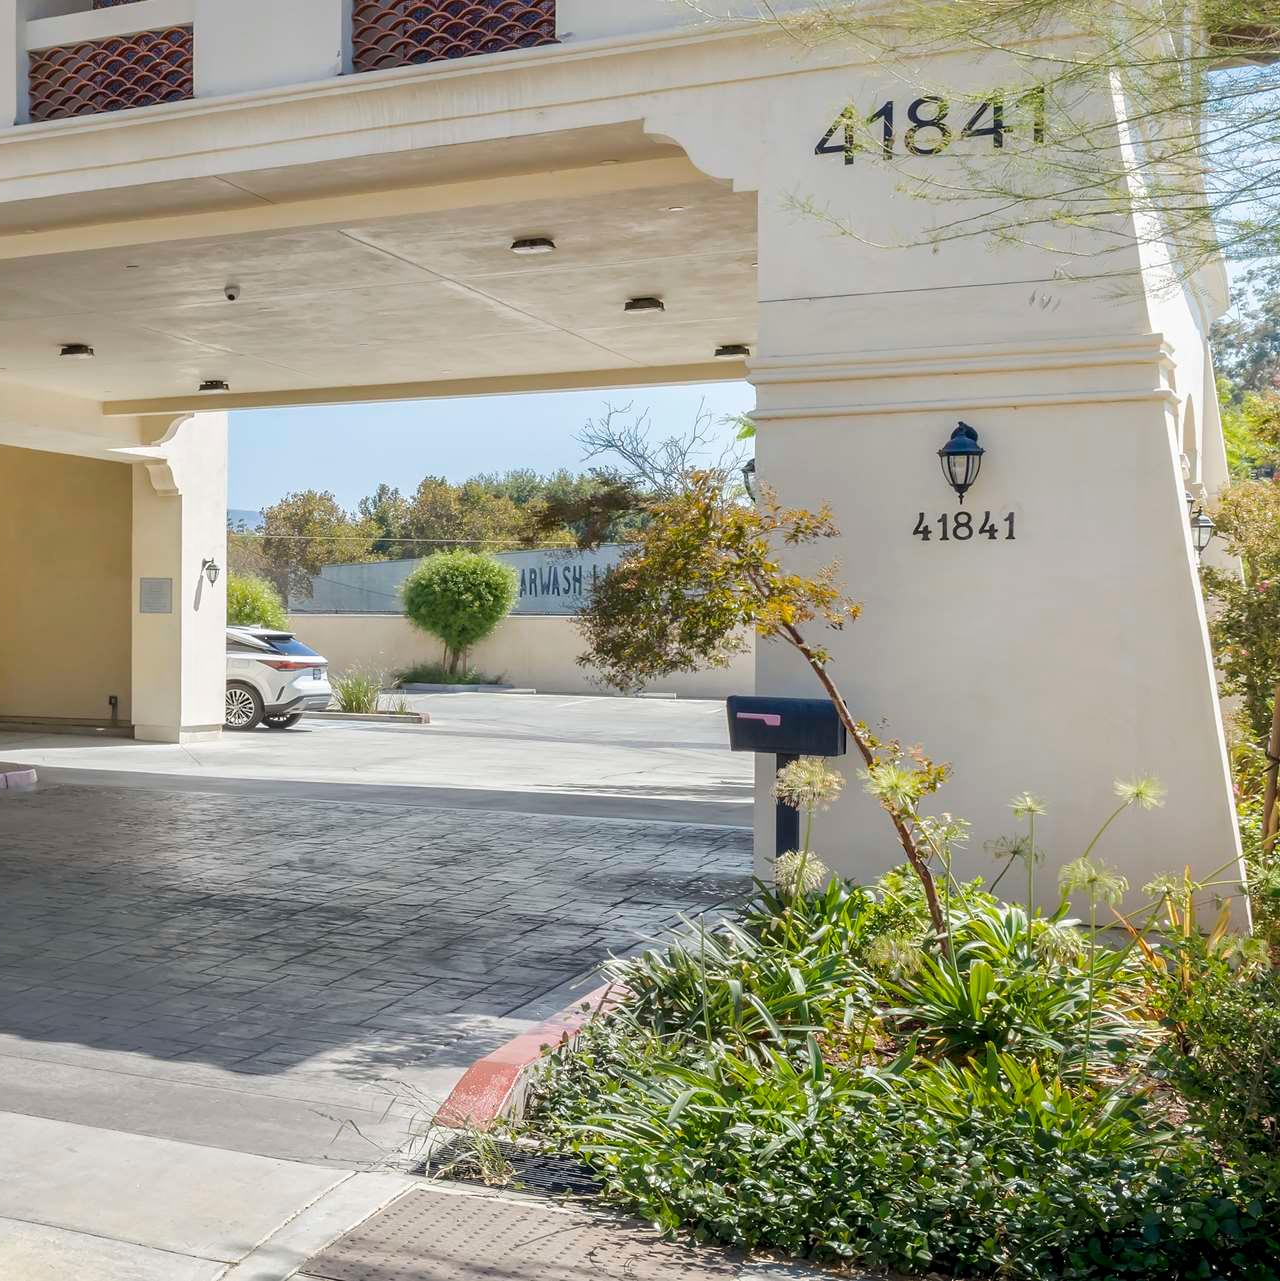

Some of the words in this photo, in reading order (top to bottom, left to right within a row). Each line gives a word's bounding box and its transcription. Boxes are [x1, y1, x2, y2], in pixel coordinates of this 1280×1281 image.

[814, 86, 1045, 166] 41841
[912, 511, 1017, 542] 41841
[519, 564, 583, 598] ARWASH
